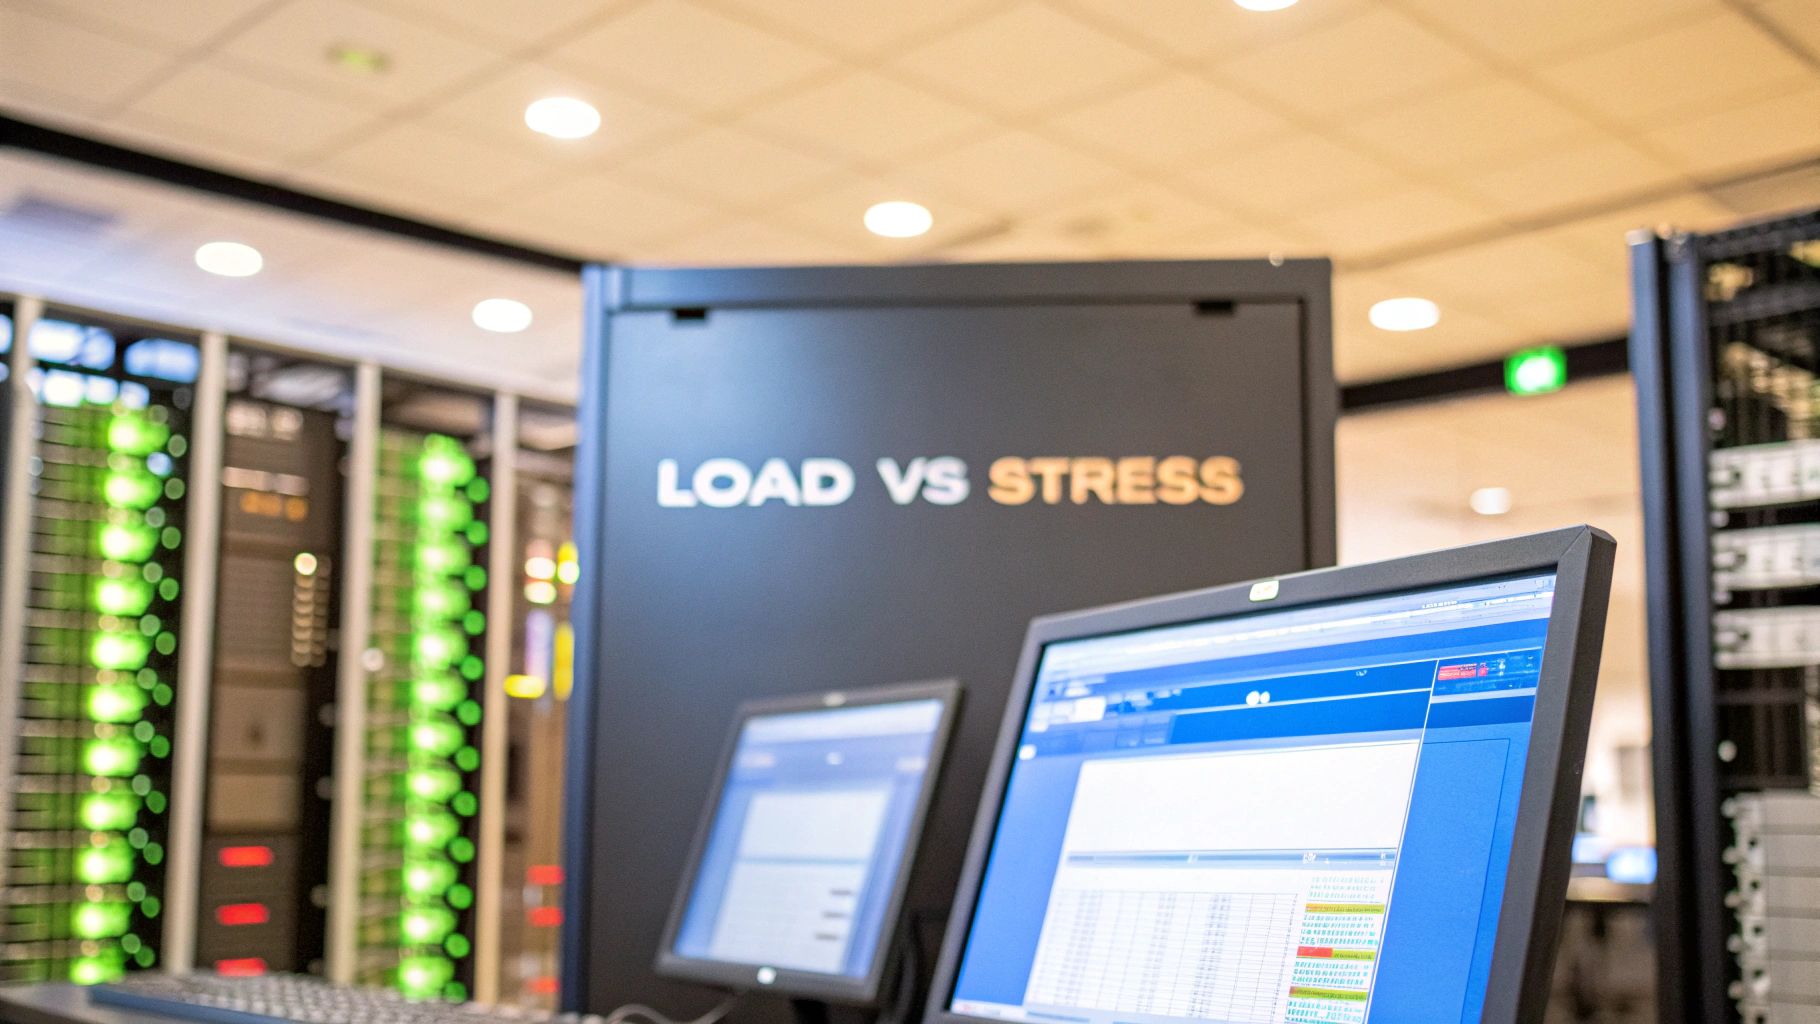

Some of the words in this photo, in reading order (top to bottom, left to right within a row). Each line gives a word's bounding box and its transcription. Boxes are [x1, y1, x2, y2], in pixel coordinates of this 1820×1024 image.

[657, 457, 855, 508] LOAD
[877, 456, 970, 505] VS
[988, 455, 1244, 505] STRESS
